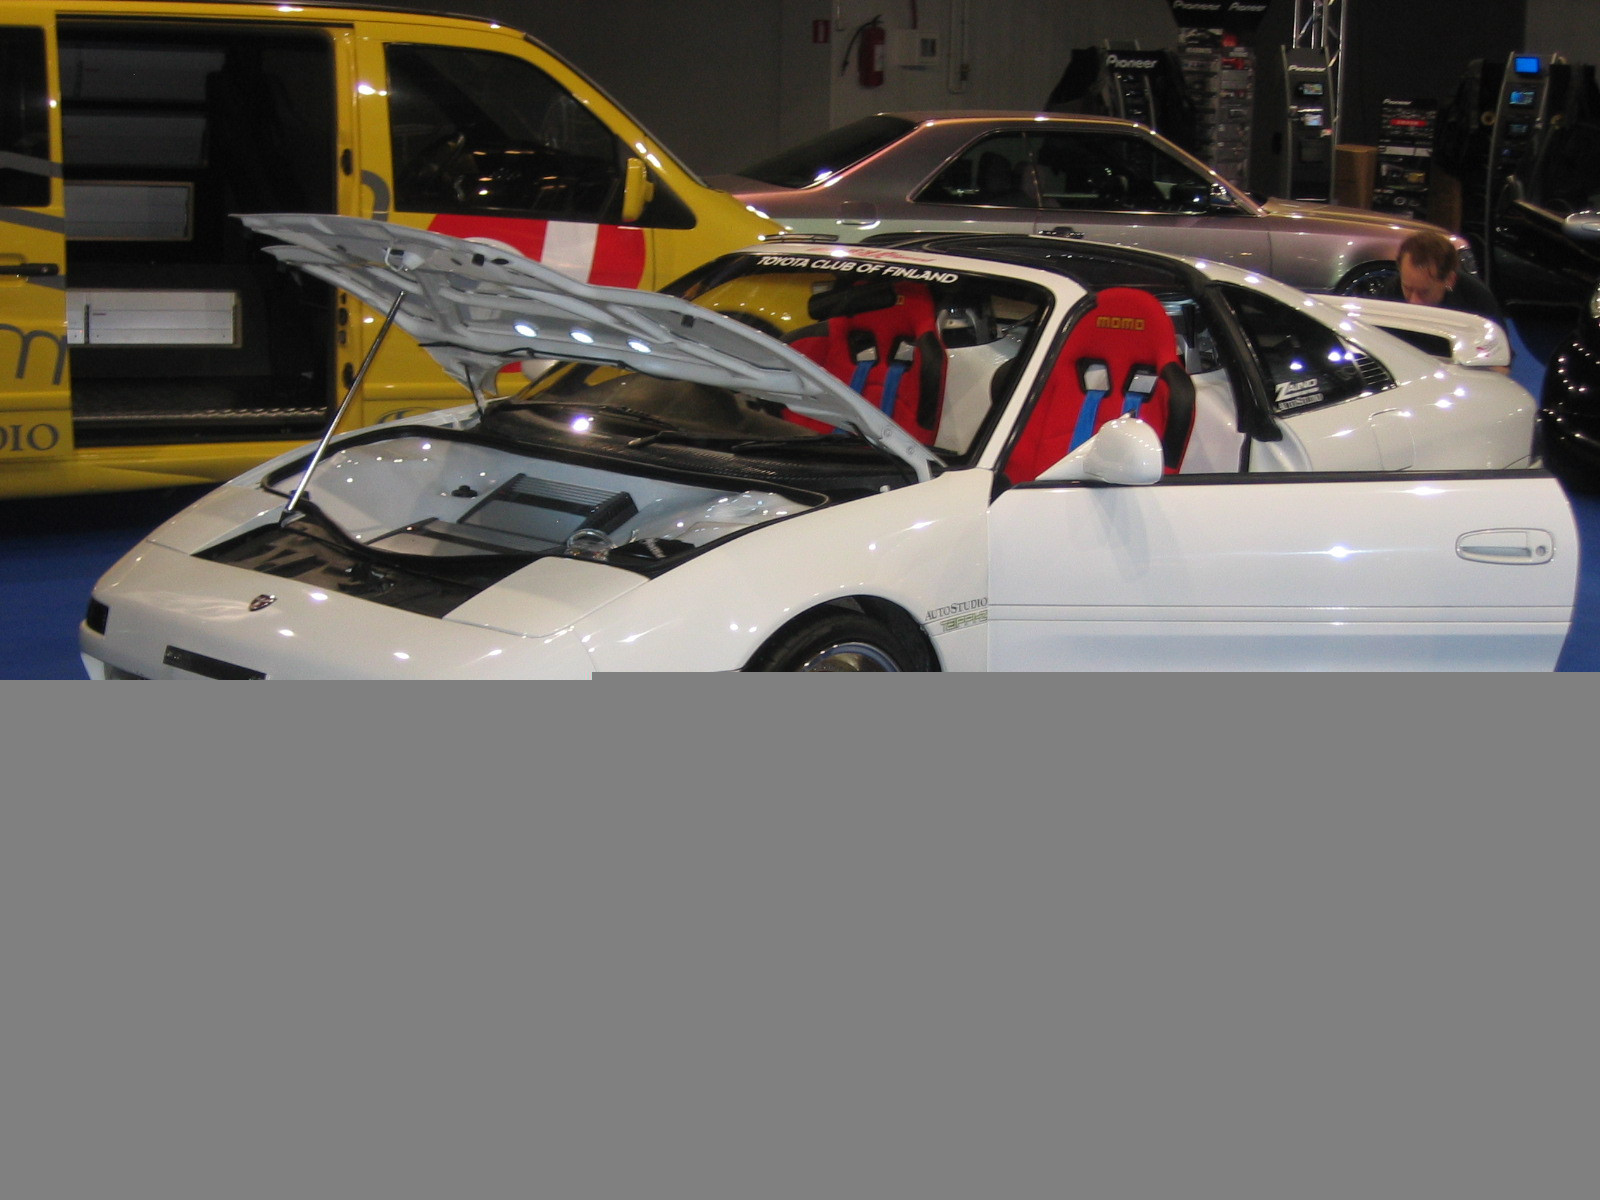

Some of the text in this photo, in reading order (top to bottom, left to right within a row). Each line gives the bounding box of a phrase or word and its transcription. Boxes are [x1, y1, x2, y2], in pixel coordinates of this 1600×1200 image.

[1105, 54, 1158, 69] Pioneer
[756, 255, 959, 284] TOYOTA CLUB OF FINLAND
